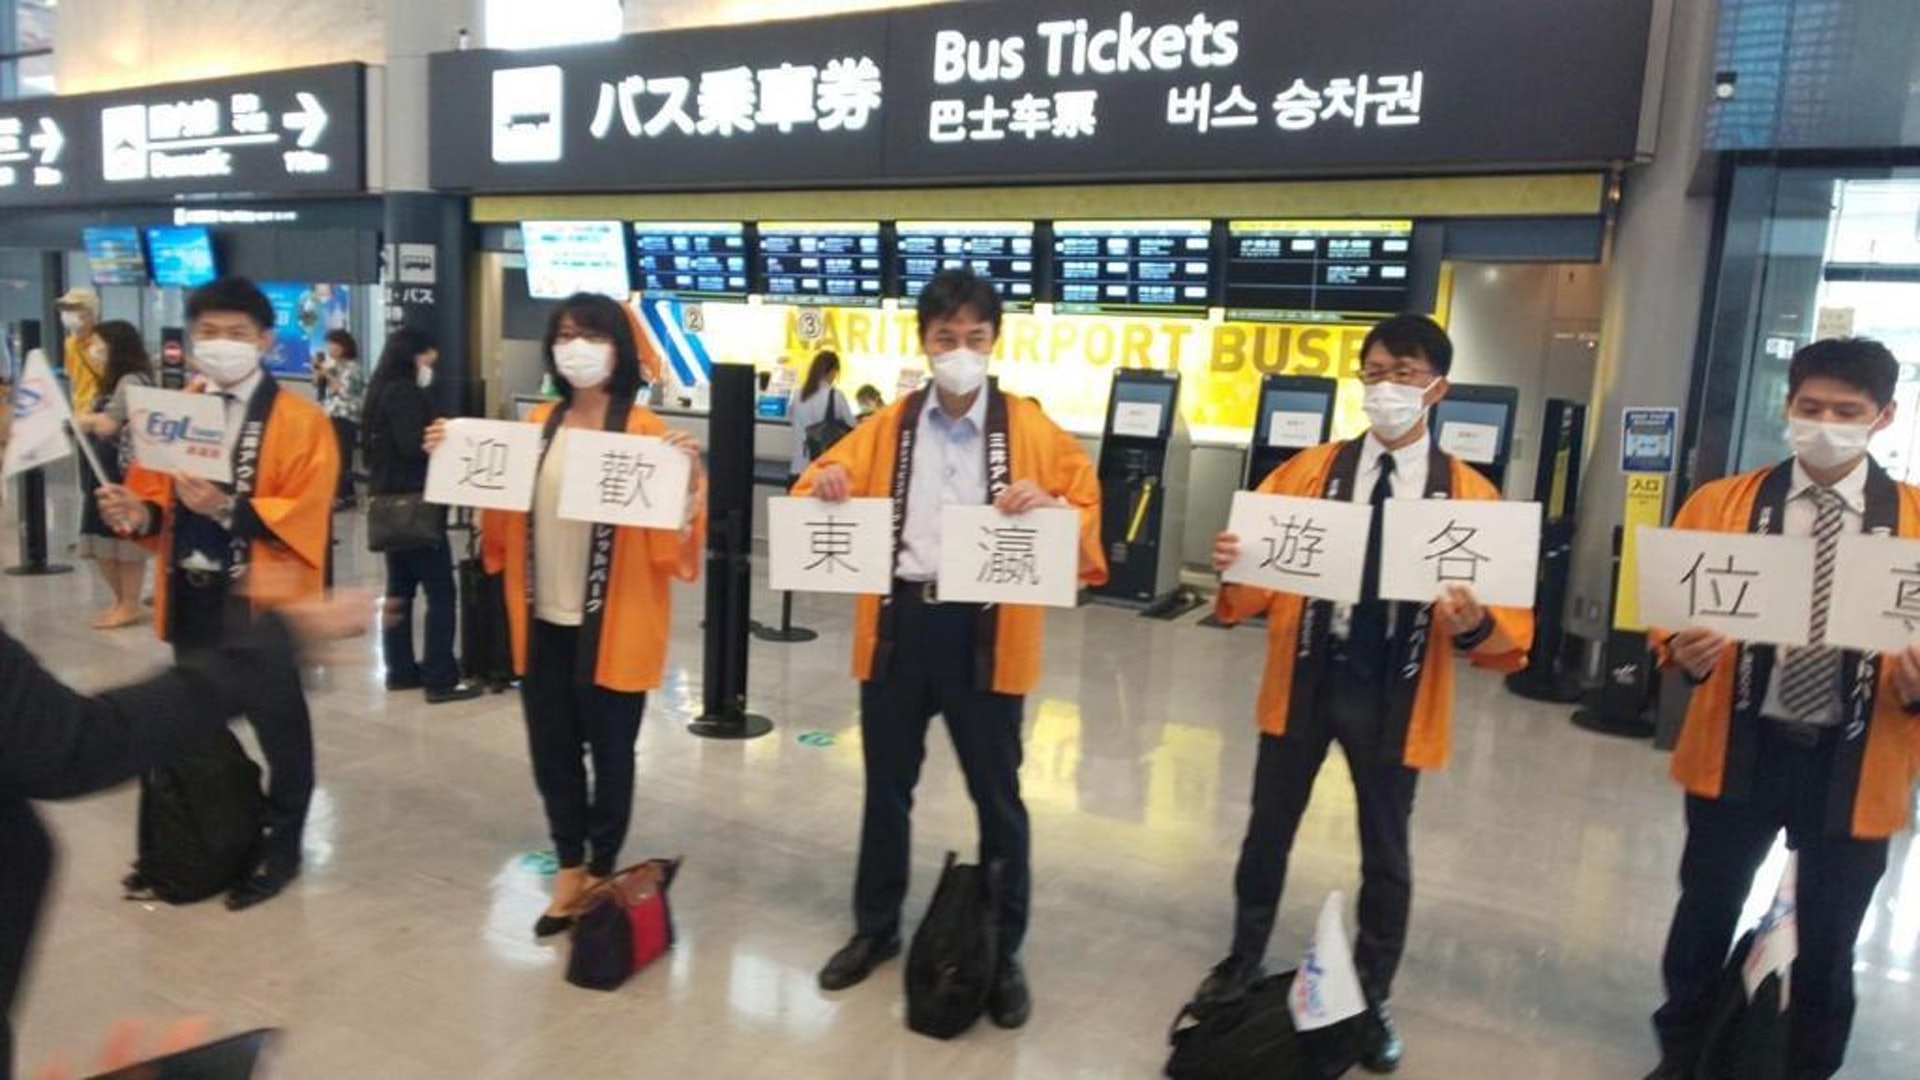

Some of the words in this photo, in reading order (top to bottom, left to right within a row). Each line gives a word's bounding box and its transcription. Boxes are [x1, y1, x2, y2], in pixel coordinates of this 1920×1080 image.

[934, 29, 1025, 85] Bus
[1037, 11, 1240, 78] Tickets
[589, 56, 883, 139] バス乗車券
[928, 89, 1098, 143] 巴士车票
[1166, 82, 1260, 135] 버스
[1272, 71, 1425, 131] 승차권
[786, 309, 922, 354] NARIT
[1209, 326, 1366, 377] BUSE
[459, 437, 510, 491] 迎
[598, 449, 657, 508] 歡
[802, 514, 860, 574] 東
[976, 521, 1041, 587] 瀛
[1260, 513, 1328, 578] 遊
[1424, 519, 1492, 583] 各
[1679, 551, 1760, 619] 位
